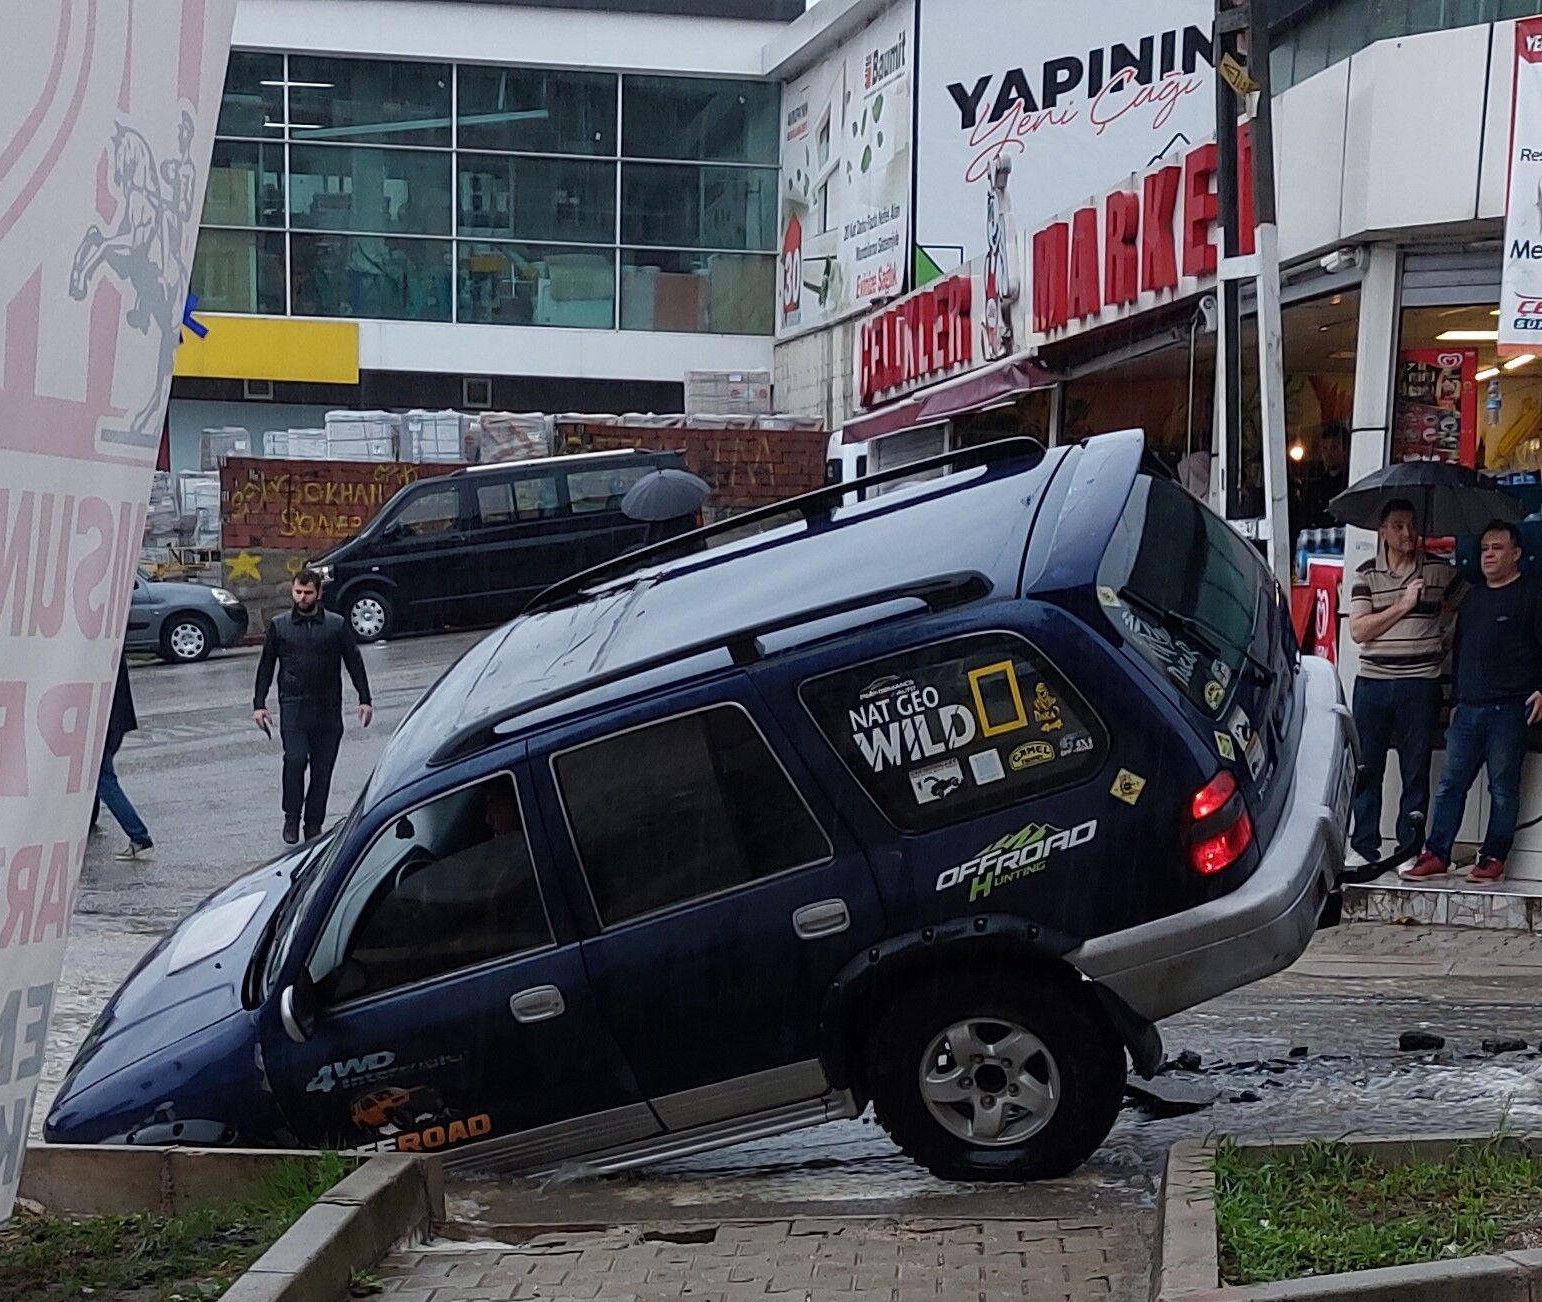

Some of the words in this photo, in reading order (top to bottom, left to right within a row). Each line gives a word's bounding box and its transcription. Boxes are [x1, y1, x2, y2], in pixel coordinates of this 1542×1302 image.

[872, 29, 906, 86] Baumit
[966, 98, 1081, 183] Yeni
[1090, 66, 1204, 136] Çağı
[784, 247, 801, 306] 30
[848, 698, 891, 732] NAT
[896, 686, 939, 717] GEO
[853, 704, 977, 773] WILD
[1012, 744, 1052, 763] CAMEL
[935, 819, 1098, 892] OFFROAD
[969, 860, 1047, 903] HUNTING
[306, 1051, 396, 1093] 4WD
